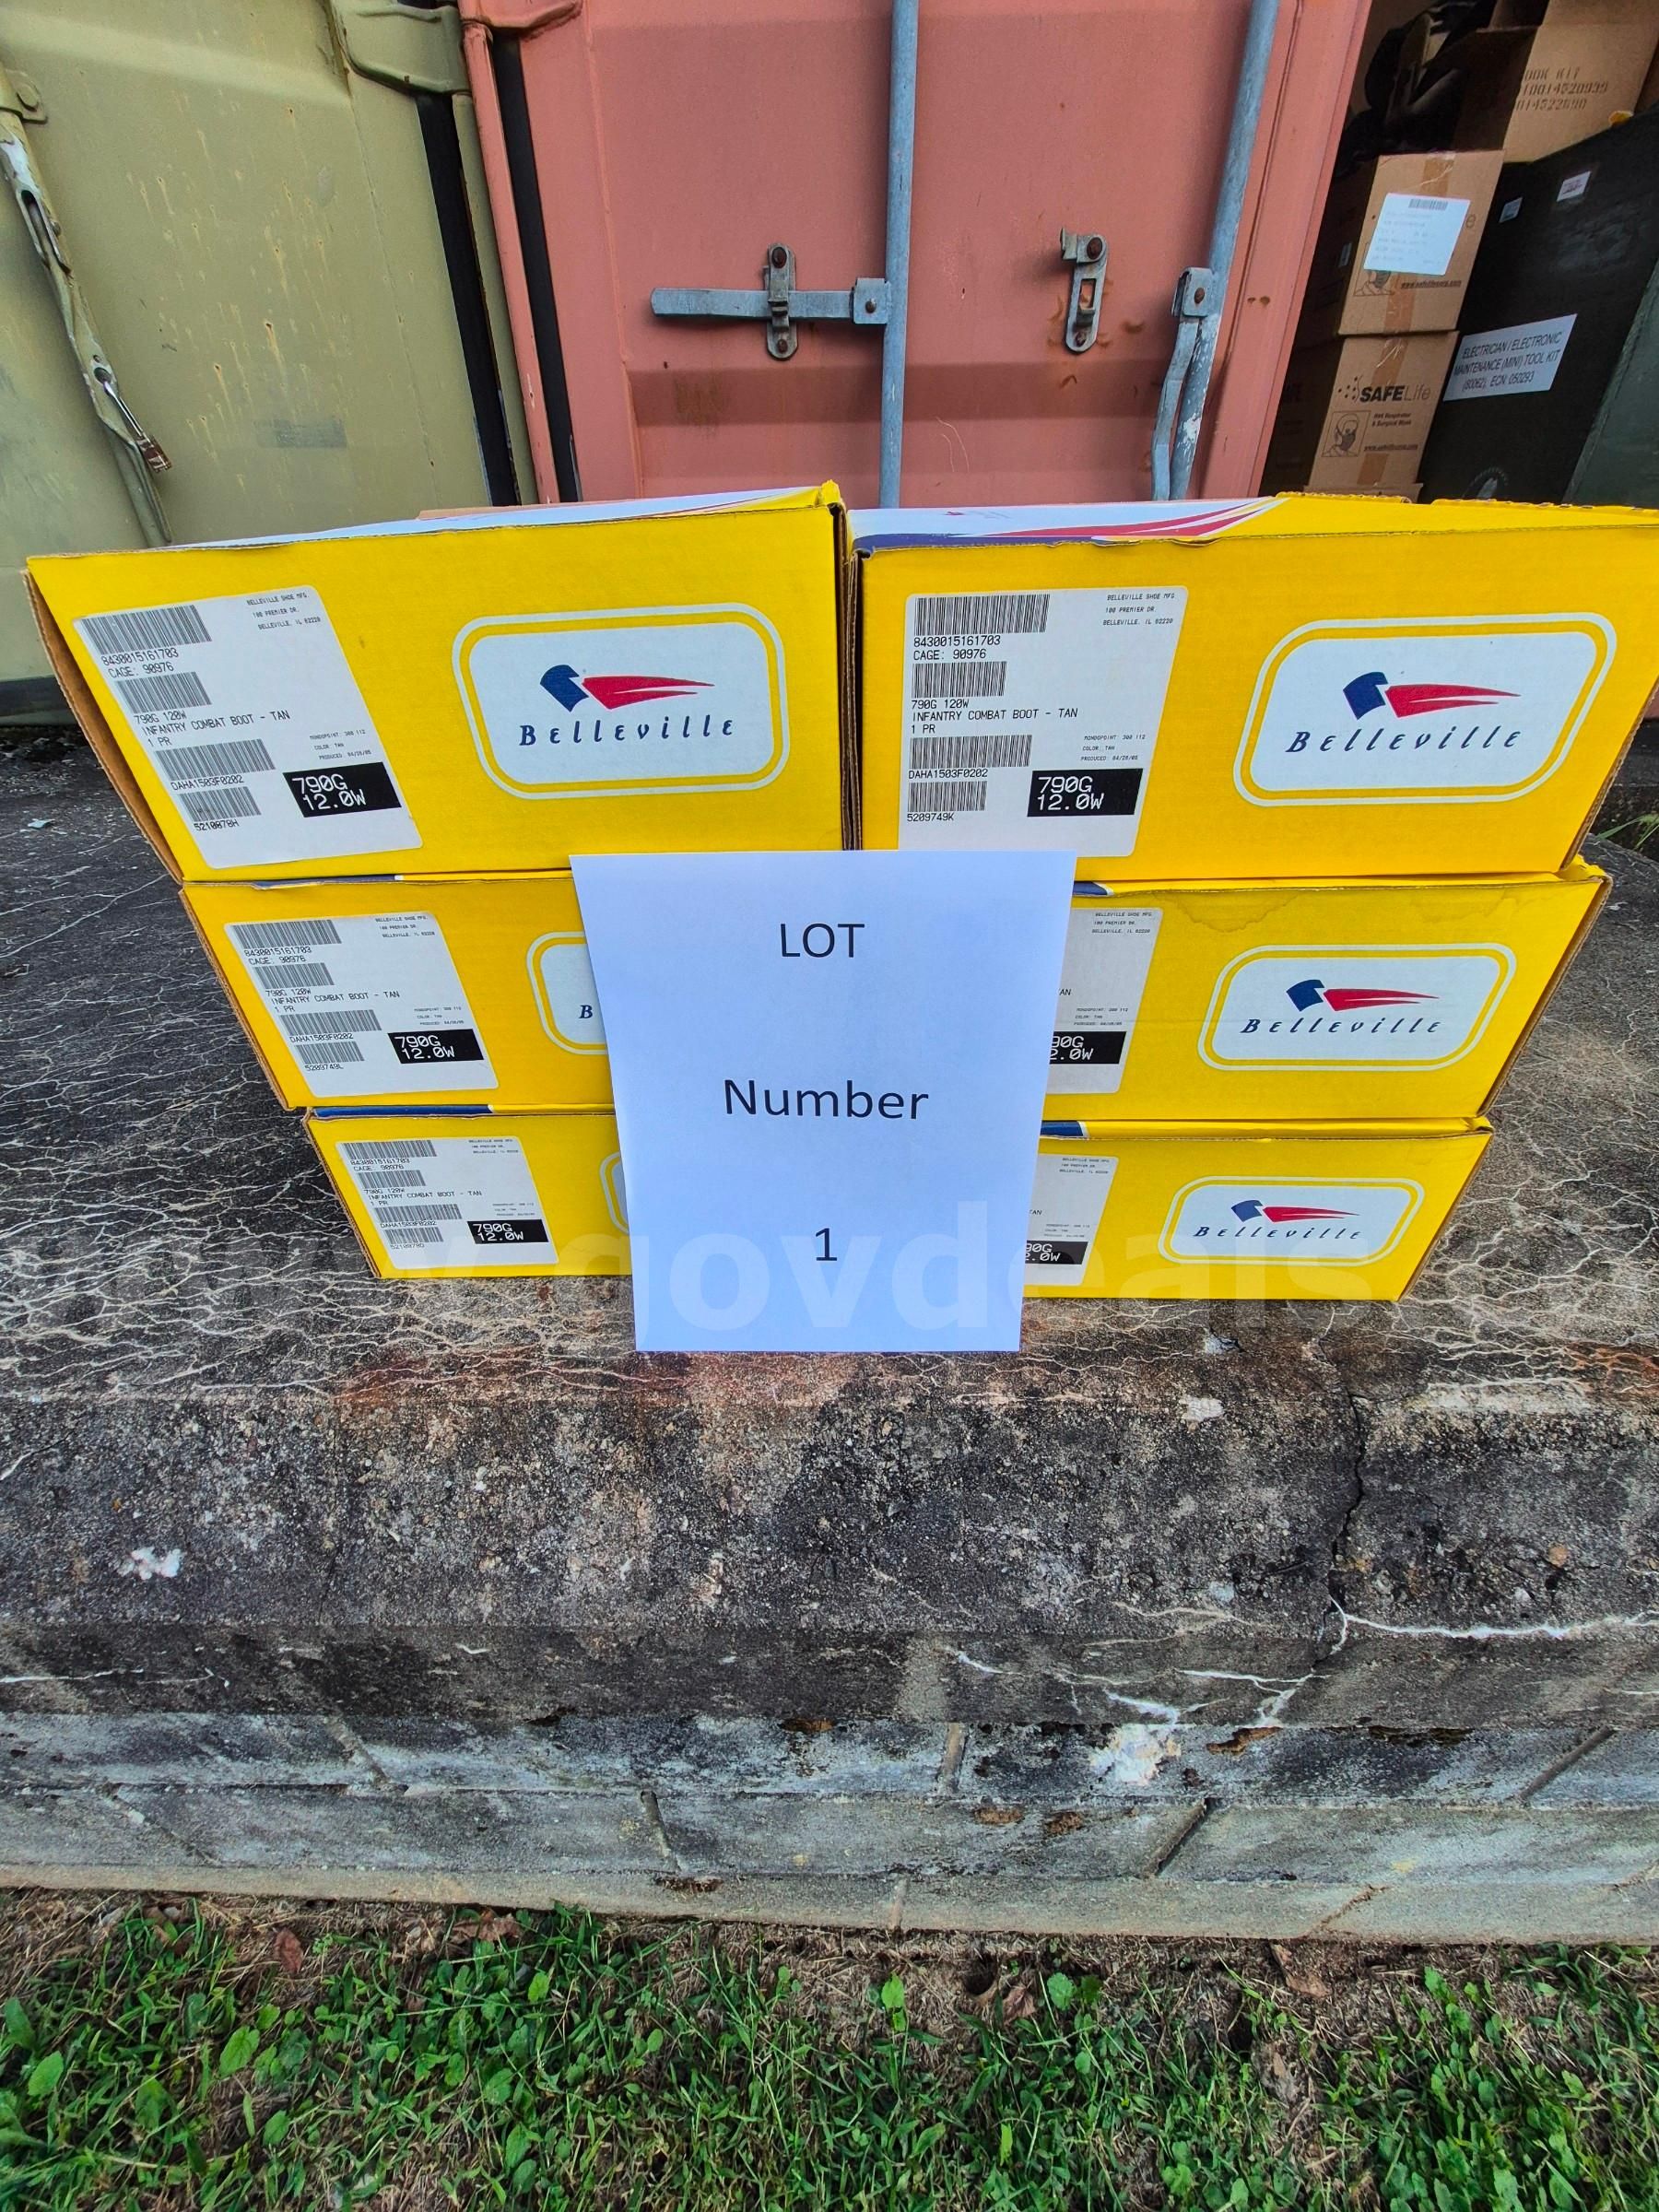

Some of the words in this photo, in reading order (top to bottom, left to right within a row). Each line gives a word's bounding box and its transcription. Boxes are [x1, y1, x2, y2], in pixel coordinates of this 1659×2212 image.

[1524, 353, 1544, 366] TOOL
[1545, 349, 1560, 362] KIT
[913, 634, 1001, 647] 8430015161703
[101, 647, 179, 665] 8430015161703
[913, 649, 945, 660] CAGE:
[953, 648, 987, 660] 90976
[108, 666, 139, 678] CAGE:
[142, 661, 174, 674] 90976
[912, 700, 937, 710] 790G
[944, 699, 970, 709] 120W
[134, 713, 159, 724] 790G
[163, 710, 187, 722] 120W
[912, 711, 962, 722] INFANTRY
[968, 710, 1006, 720] COMBAT
[1013, 709, 1040, 719] BOOT
[1058, 708, 1078, 718] TAN
[142, 723, 187, 735] INFANTRY
[191, 717, 227, 731] COMBAT
[231, 713, 254, 726] BOOT
[269, 710, 291, 721] TAN
[923, 724, 935, 734] PR
[519, 714, 734, 747] Belleville
[158, 736, 172, 747] PR
[1286, 725, 1522, 753] Belleville
[908, 769, 988, 779] DAHA1503F0202
[292, 773, 348, 794] 790G
[1038, 776, 1093, 794] 790G
[302, 788, 367, 811] 12.0W
[1037, 793, 1104, 811] 12.0W
[906, 812, 954, 822] 5209749K
[781, 924, 865, 958] LOT
[249, 958, 275, 966] CAGE:
[279, 955, 307, 964] 90976
[271, 995, 310, 1006] INFANTRY
[314, 994, 345, 1003] COMBAT
[348, 992, 369, 1000] BOOT
[1240, 1018, 1441, 1034] Belleville
[394, 1035, 441, 1048] 790G
[1052, 1035, 1085, 1048] 90G
[402, 1045, 455, 1060] 12.0W
[1050, 1048, 1094, 1060] 2.0W
[724, 1078, 929, 1120] Number
[473, 1223, 512, 1233] 790G
[1193, 1226, 1361, 1240] Belleville
[477, 1231, 524, 1241] 12.0W
[814, 1228, 838, 1262] 1
